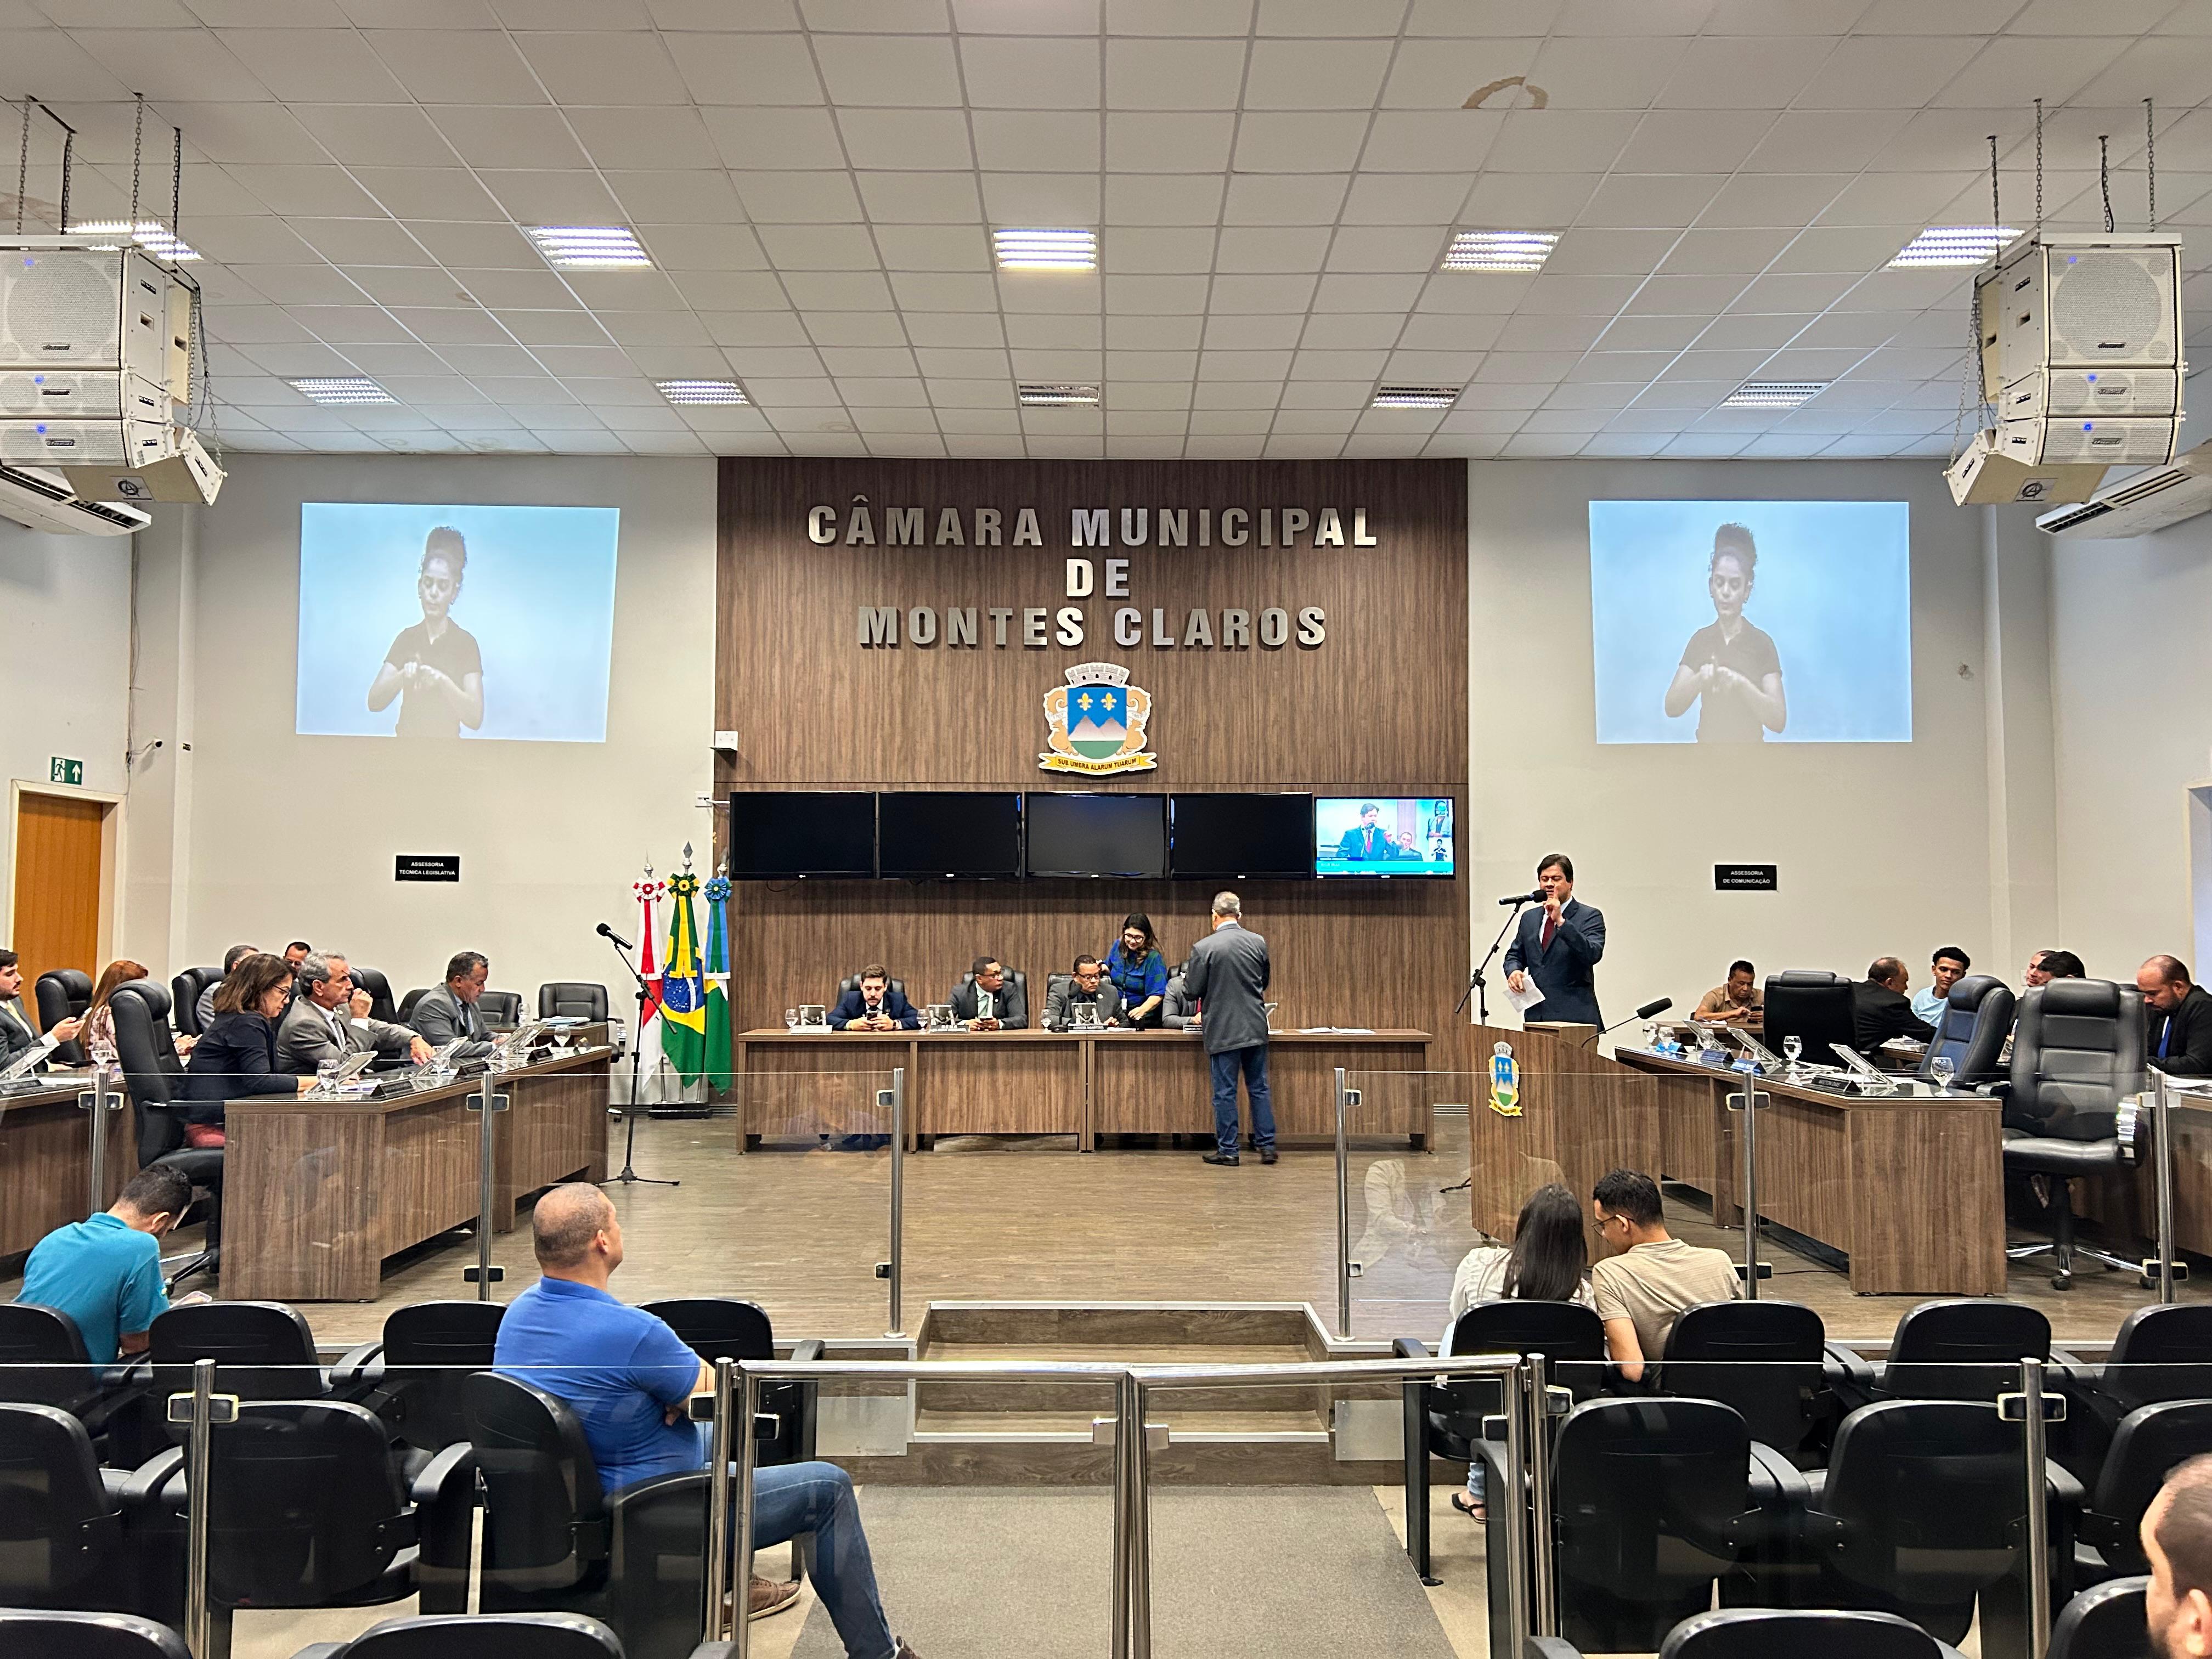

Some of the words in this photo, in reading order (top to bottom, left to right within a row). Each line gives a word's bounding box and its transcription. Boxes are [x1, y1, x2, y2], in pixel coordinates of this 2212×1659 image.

[808, 494, 1043, 546] CÂMARA
[1071, 507, 1378, 546] MUNICIPAL
[1066, 558, 1130, 597] DE
[857, 606, 1085, 646] MONTES
[1114, 606, 1326, 646] CLAROS
[1070, 760, 1090, 770] UMBRA
[1114, 758, 1137, 768] TUARUM
